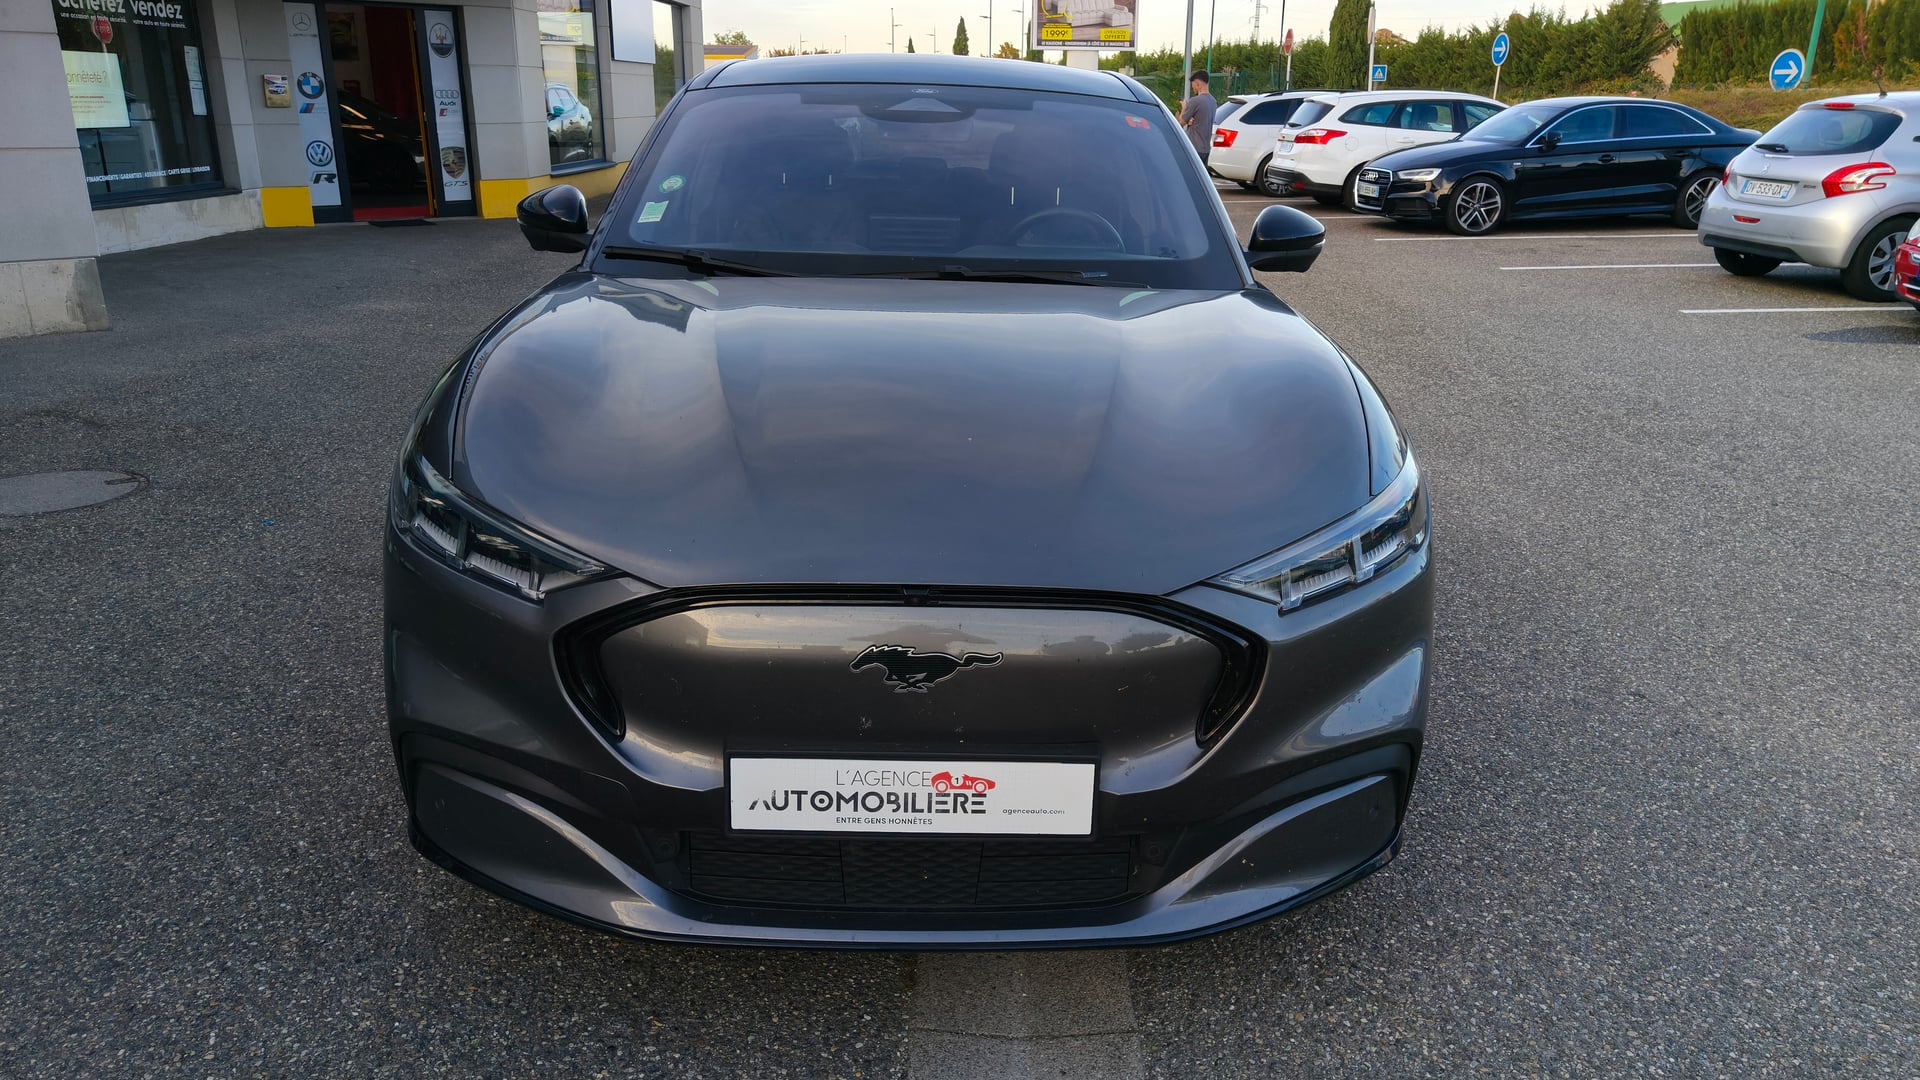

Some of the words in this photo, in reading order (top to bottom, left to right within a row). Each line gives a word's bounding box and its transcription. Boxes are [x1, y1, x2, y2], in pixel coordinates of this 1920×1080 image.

[131, 0, 183, 19] vendez
[836, 770, 932, 787] L'AGENCE
[1002, 808, 1065, 816] agenceauto.com
[888, 817, 933, 825] HONNÊTES
